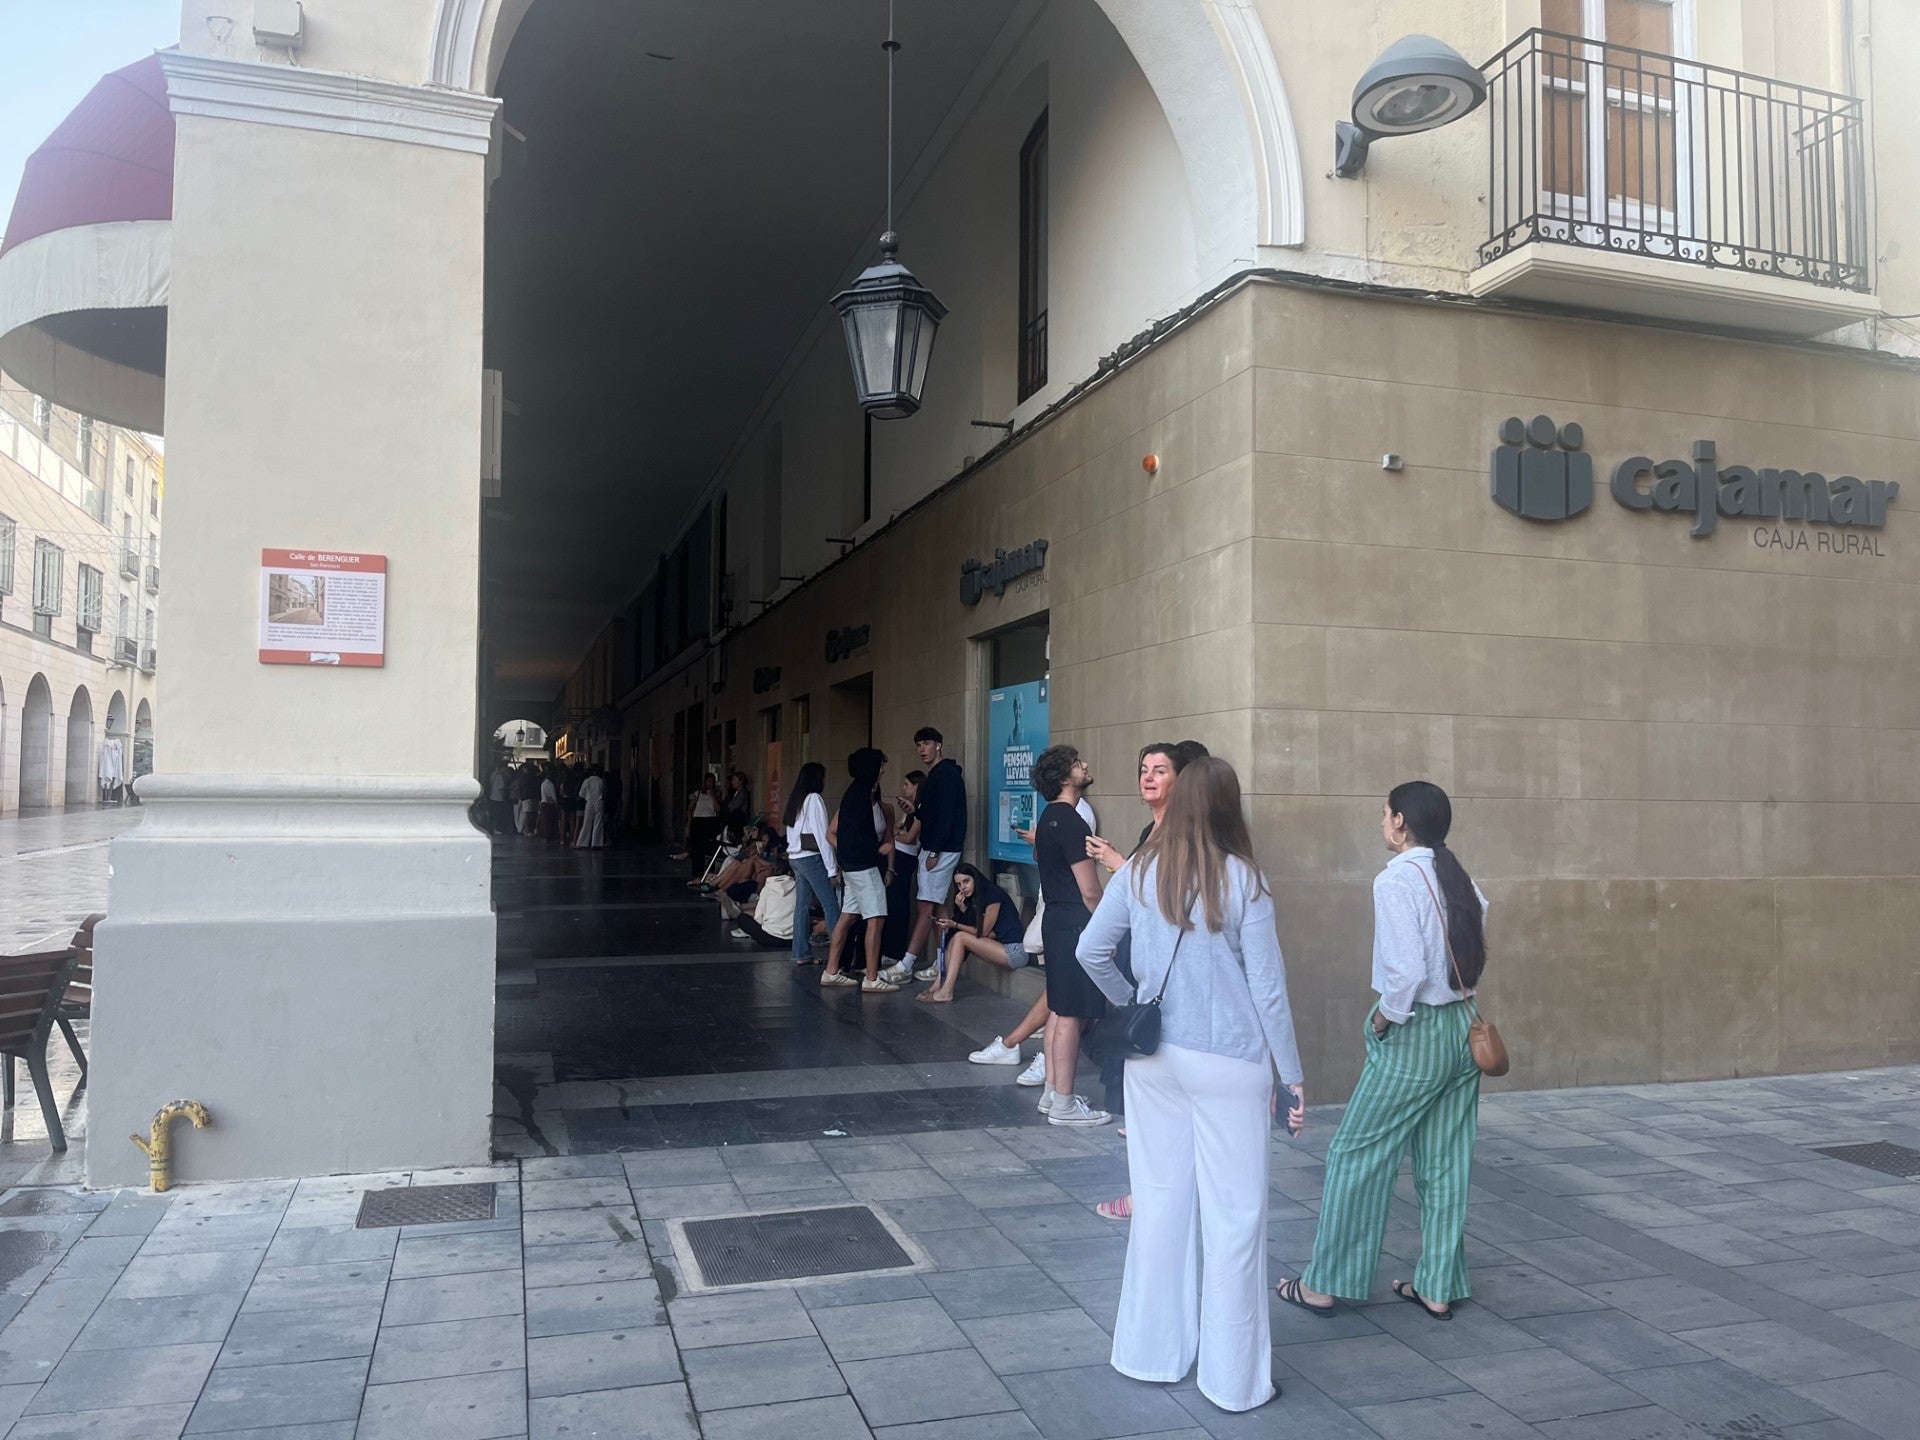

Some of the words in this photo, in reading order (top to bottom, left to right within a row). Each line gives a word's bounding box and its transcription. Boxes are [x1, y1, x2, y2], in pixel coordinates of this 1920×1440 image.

[1610, 440, 1899, 538] cajamar
[1753, 526, 1809, 551] CAJA
[1817, 531, 1886, 557] RURAL
[289, 552, 306, 561] Calle
[318, 554, 360, 564] BERENGUER
